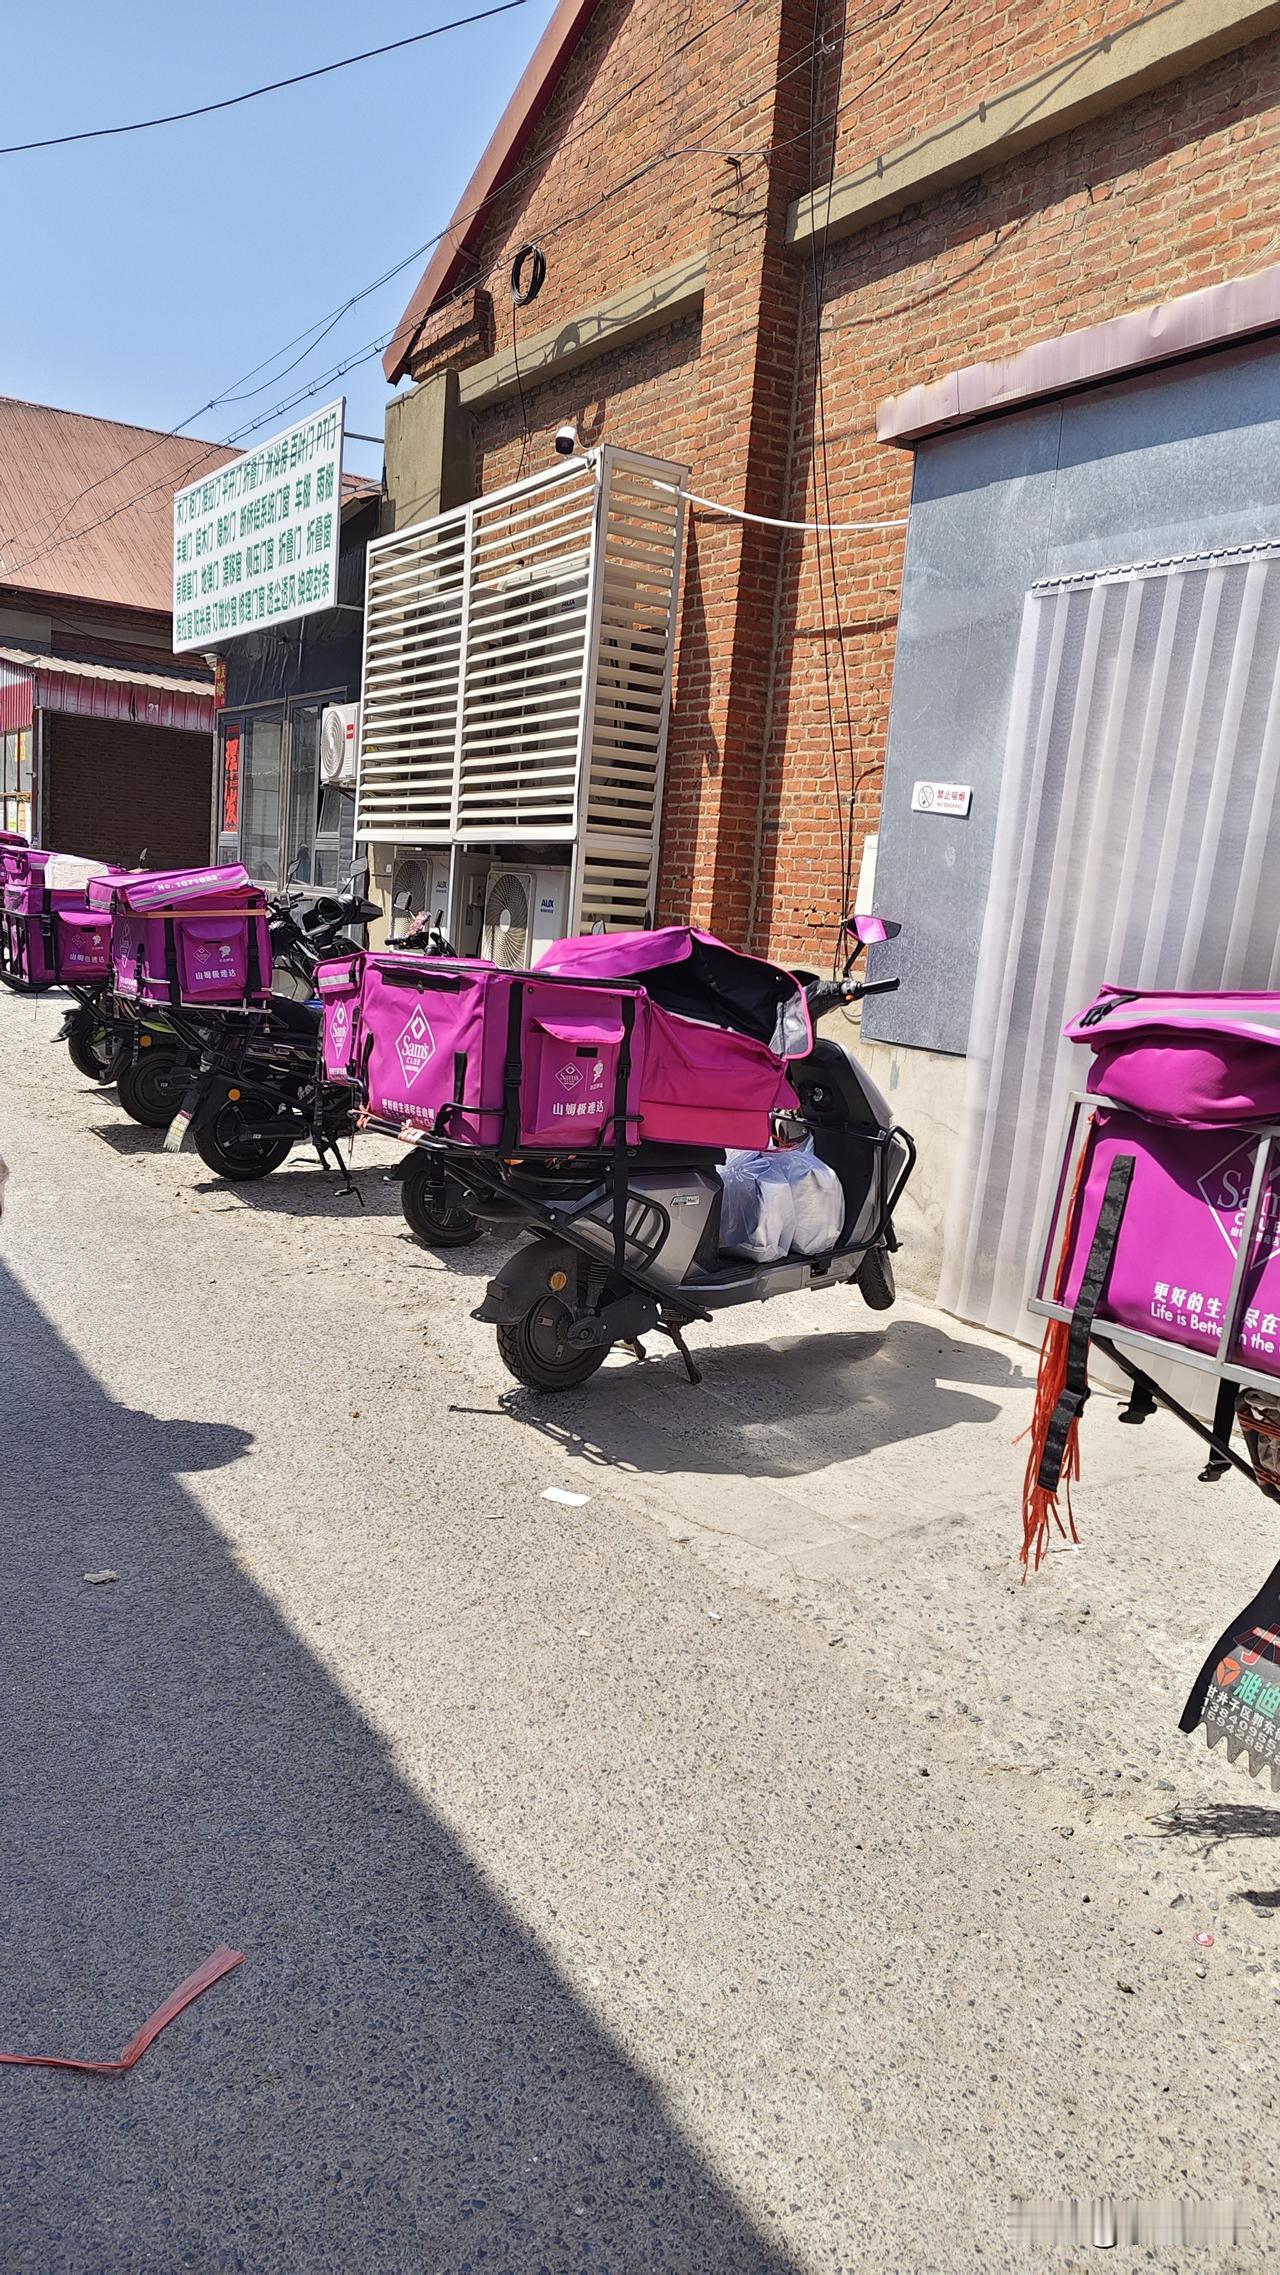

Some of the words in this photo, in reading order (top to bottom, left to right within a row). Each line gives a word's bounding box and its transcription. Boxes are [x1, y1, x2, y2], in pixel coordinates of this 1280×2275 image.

[221, 467, 241, 501] 平开门
[277, 525, 302, 565] 折叠门
[306, 512, 333, 555] 折叠窗
[937, 789, 966, 801] 禁止吸烟
[541, 899, 554, 908] AUX
[195, 968, 237, 980] 山姆极速达
[401, 1034, 430, 1060] Sam's
[552, 1100, 604, 1116] 山姆极速达
[1153, 1281, 1280, 1336] 更好的生尽在
[1151, 1301, 1173, 1322] Life
[1176, 1311, 1187, 1326] is
[1190, 1314, 1224, 1338] Bette
[1250, 1333, 1274, 1353] the
[1233, 1669, 1280, 1720] 雅迪
